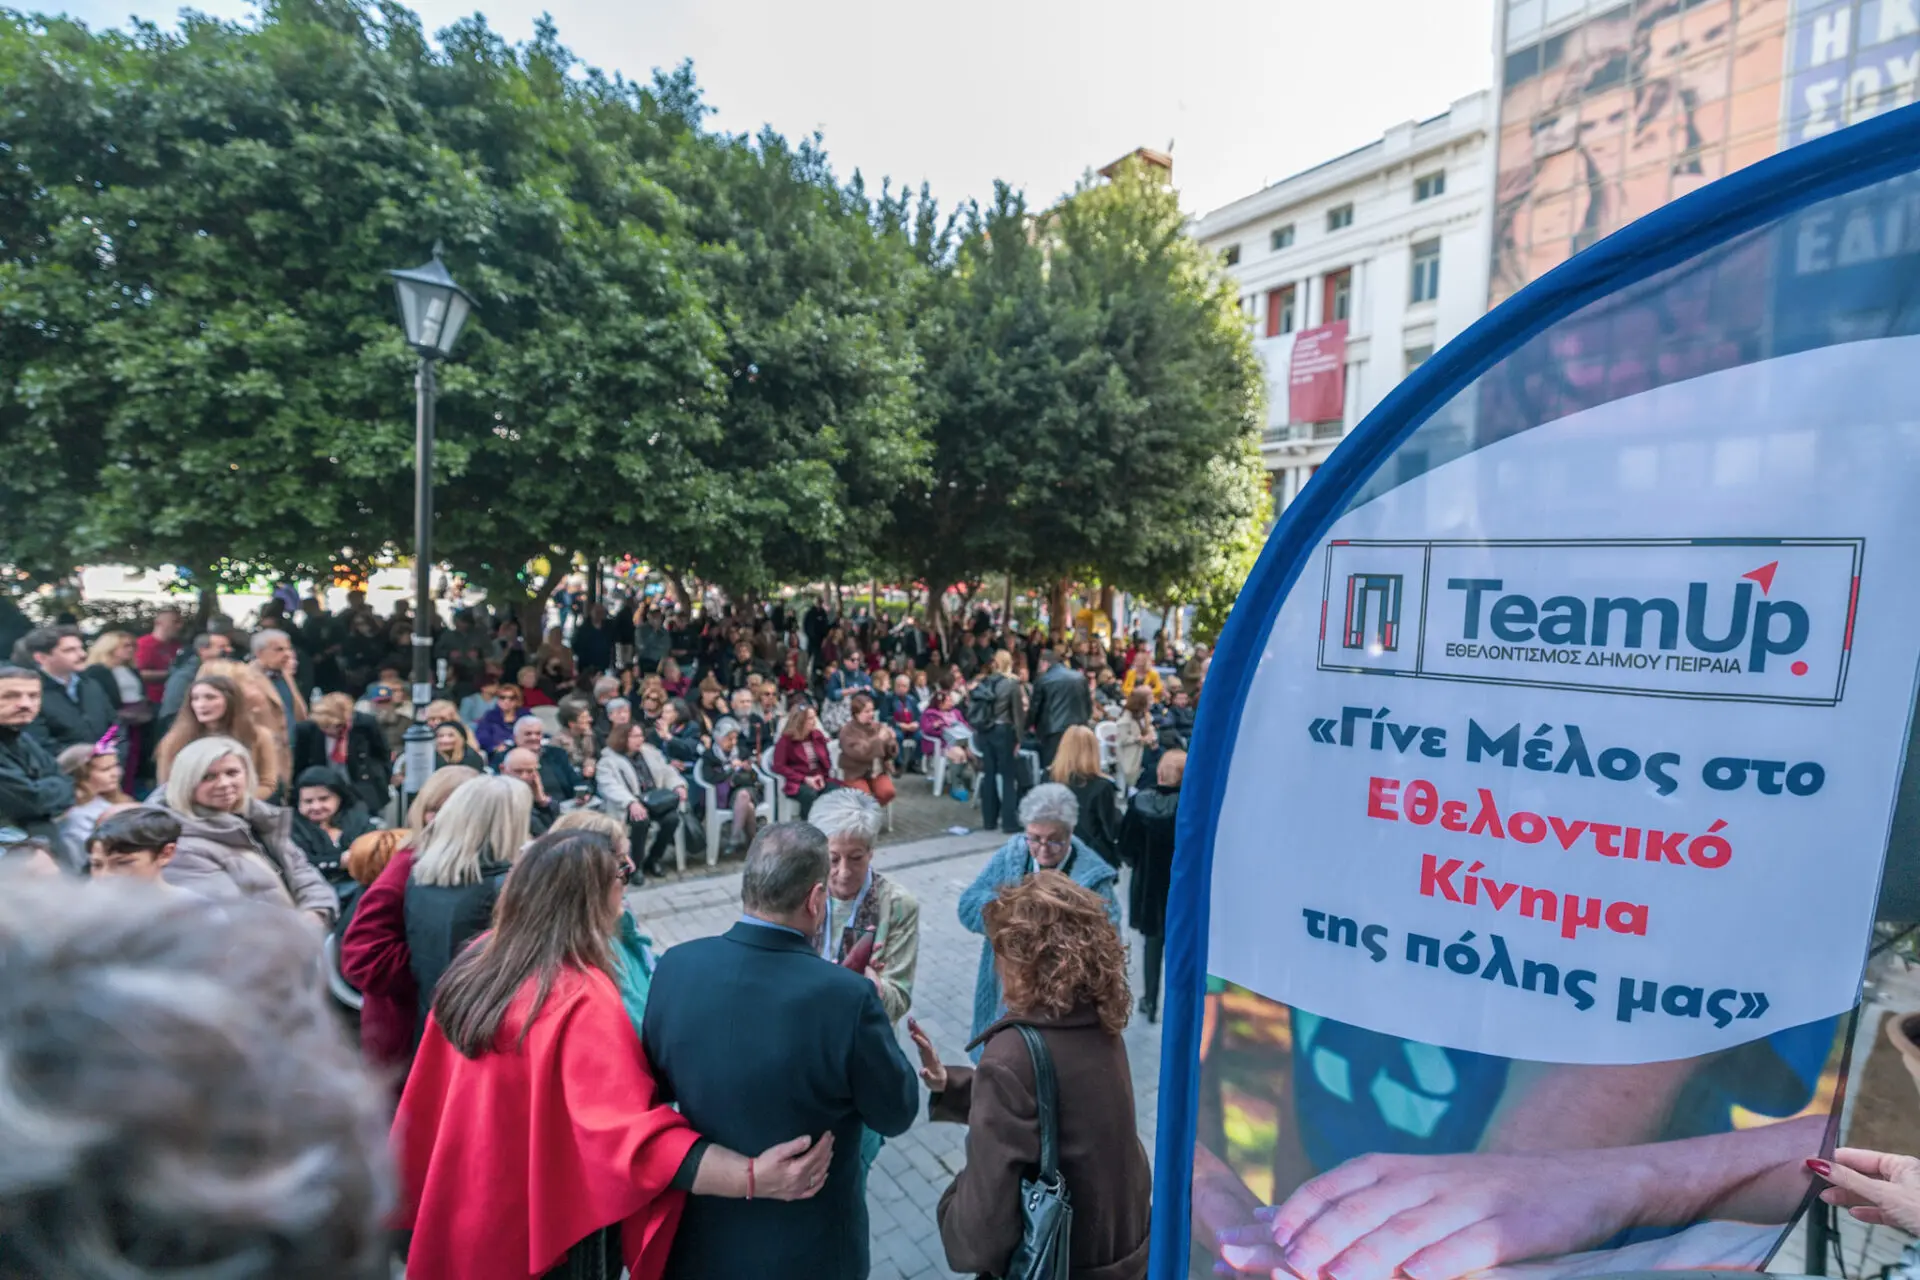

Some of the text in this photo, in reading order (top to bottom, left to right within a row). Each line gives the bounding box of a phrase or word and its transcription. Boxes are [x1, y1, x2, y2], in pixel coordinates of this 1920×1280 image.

[1445, 643, 1742, 674] ΕΘΕΛΟΝΤΙΣΜΟΣ ΔΗΜΟΥ ΠΕΙΡΑΙΑ
[1447, 578, 1810, 673] TeamUp
[1308, 706, 1826, 796] «Γίνε Μέλος στο
[1367, 777, 1733, 869] Εθελοντικό
[1419, 854, 1649, 939] Κίνημα
[1302, 908, 1770, 1029] της πόλης μας»
